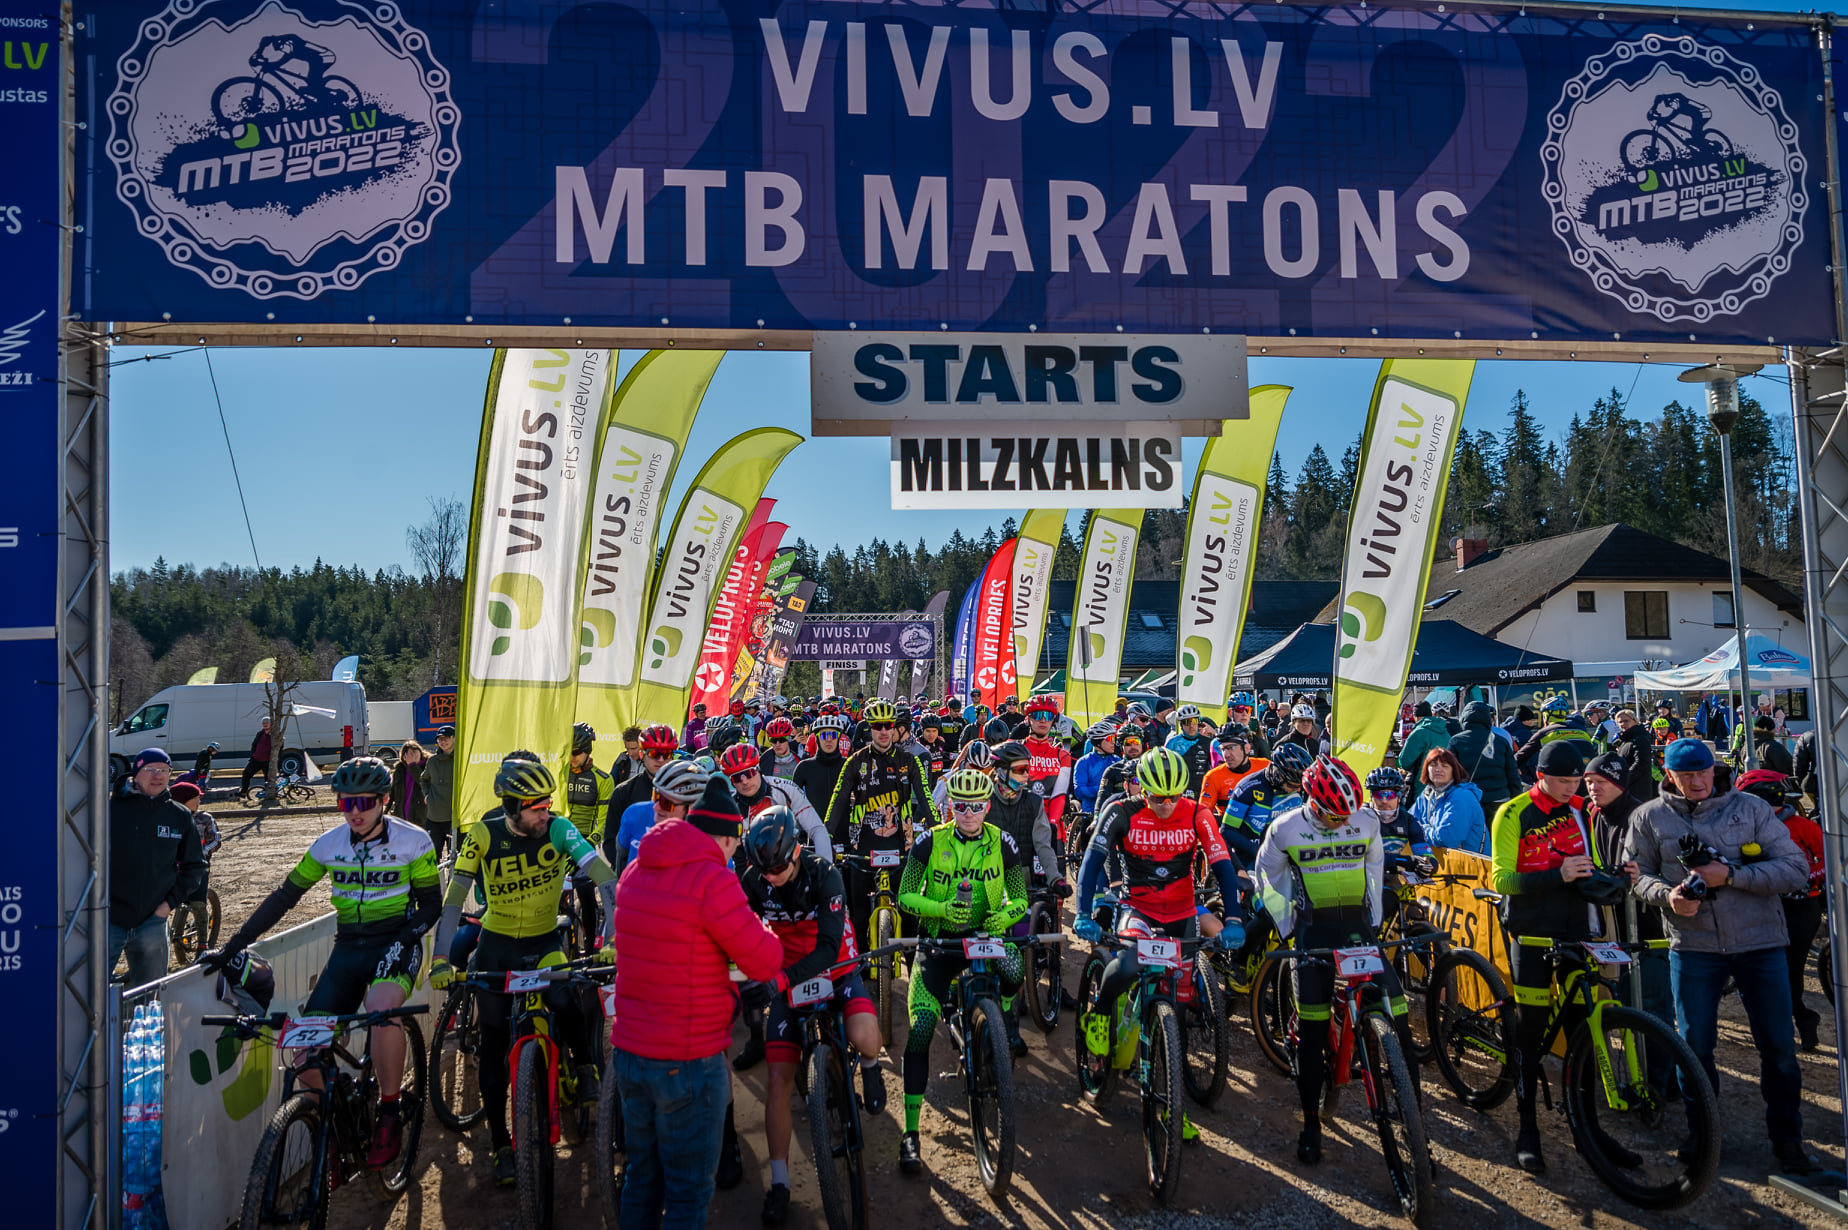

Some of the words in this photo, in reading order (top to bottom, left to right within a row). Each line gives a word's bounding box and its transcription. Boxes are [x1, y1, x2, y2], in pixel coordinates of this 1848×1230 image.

[759, 18, 1283, 129] VIVUS.LV
[288, 126, 406, 158] MARATONS
[178, 147, 285, 193] MTB
[285, 141, 402, 183] 2022
[1680, 173, 1767, 199] MARATONS
[1599, 190, 1678, 230] MTB
[1679, 186, 1765, 222] 2022
[555, 165, 806, 267] MTB
[863, 174, 1470, 282] MARATONS
[853, 343, 1184, 404] STARTS
[566, 350, 599, 440] aizdevums
[560, 446, 580, 480] ērts
[900, 437, 1174, 492] MILZKALNS
[1409, 496, 1426, 525] ērts
[1420, 413, 1445, 494] aizdevums
[636, 453, 662, 517] aizdevums
[630, 519, 644, 545] ērts
[1230, 497, 1249, 555] aizdevums
[1225, 555, 1238, 581] ērts
[813, 627, 870, 638] VIVUS.LV
[792, 643, 818, 654] MTB
[823, 643, 891, 655] MARATONS
[1288, 677, 1328, 685] VELOPROFS.LV
[1128, 829, 1196, 845] VELOPROFS
[1298, 843, 1367, 862] DAKO
[332, 870, 400, 884] DAKO
[483, 842, 561, 880] VELO
[489, 865, 560, 897] EXPRESS
[978, 945, 993, 953] 45
[1353, 959, 1366, 970] 17
[802, 982, 820, 996] 49
[296, 1030, 320, 1042] 52
